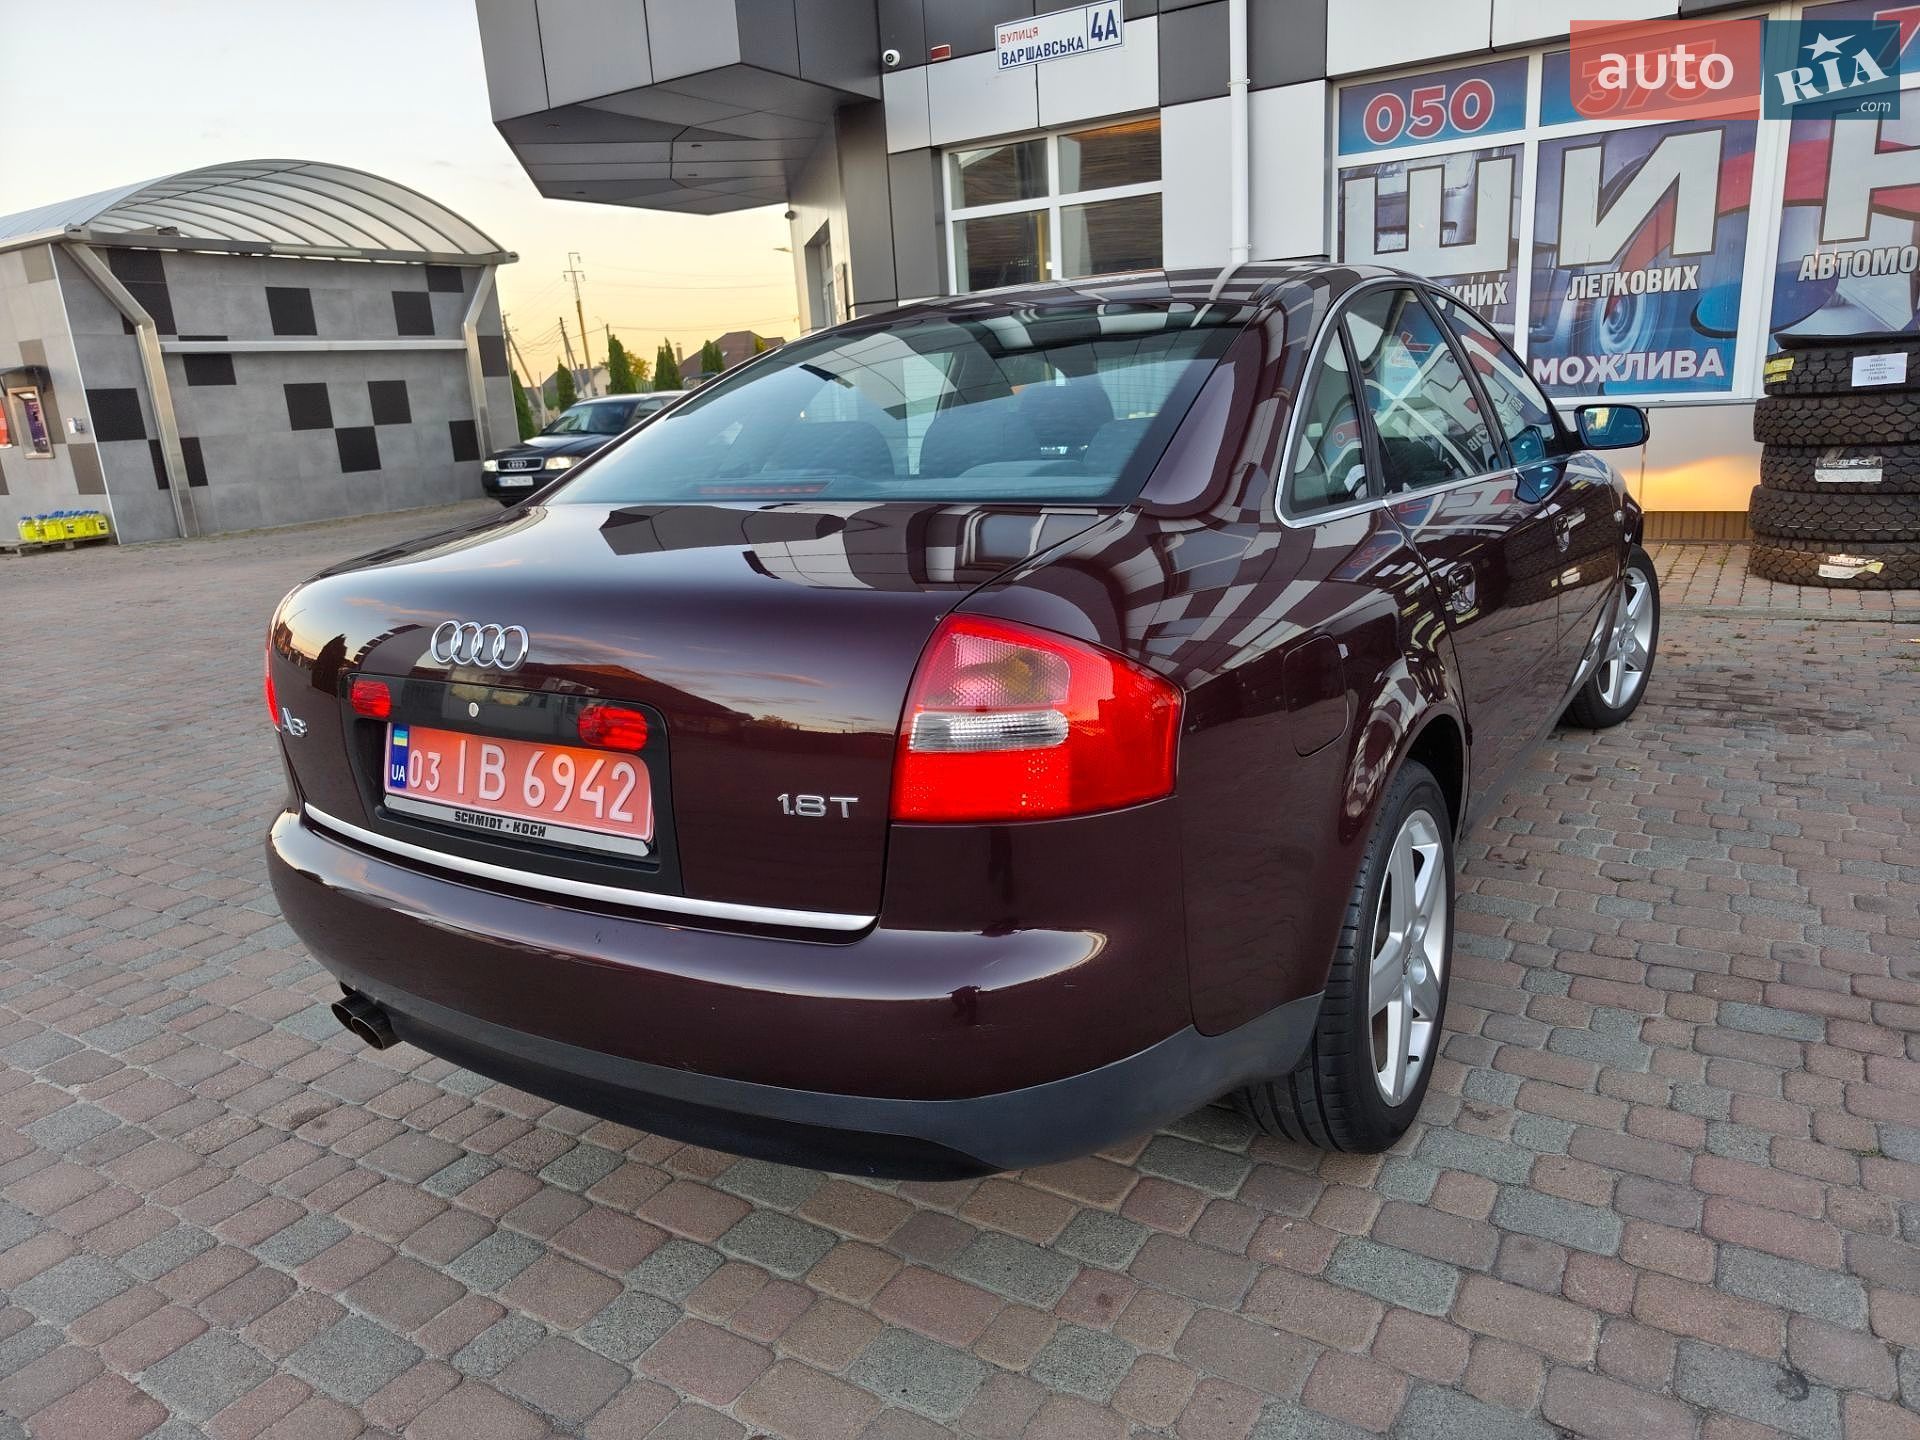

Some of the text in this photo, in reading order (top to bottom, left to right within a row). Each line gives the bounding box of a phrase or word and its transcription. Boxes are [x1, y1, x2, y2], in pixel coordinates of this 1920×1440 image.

[1000, 26, 1039, 44] ВУЛИЦЯ
[1090, 9, 1119, 42] 4А
[1001, 36, 1084, 66] ВАРШАВСЬКА
[1363, 78, 1495, 145] 050
[1575, 39, 1717, 115] 375
[1567, 265, 1700, 301] ЛЕГКОВИХ
[1532, 348, 1725, 385] МОЖЛИВА
[391, 764, 406, 783] UA
[409, 740, 637, 823] 03 IB 6942
[454, 810, 547, 838] SCHMIDT KOCH
